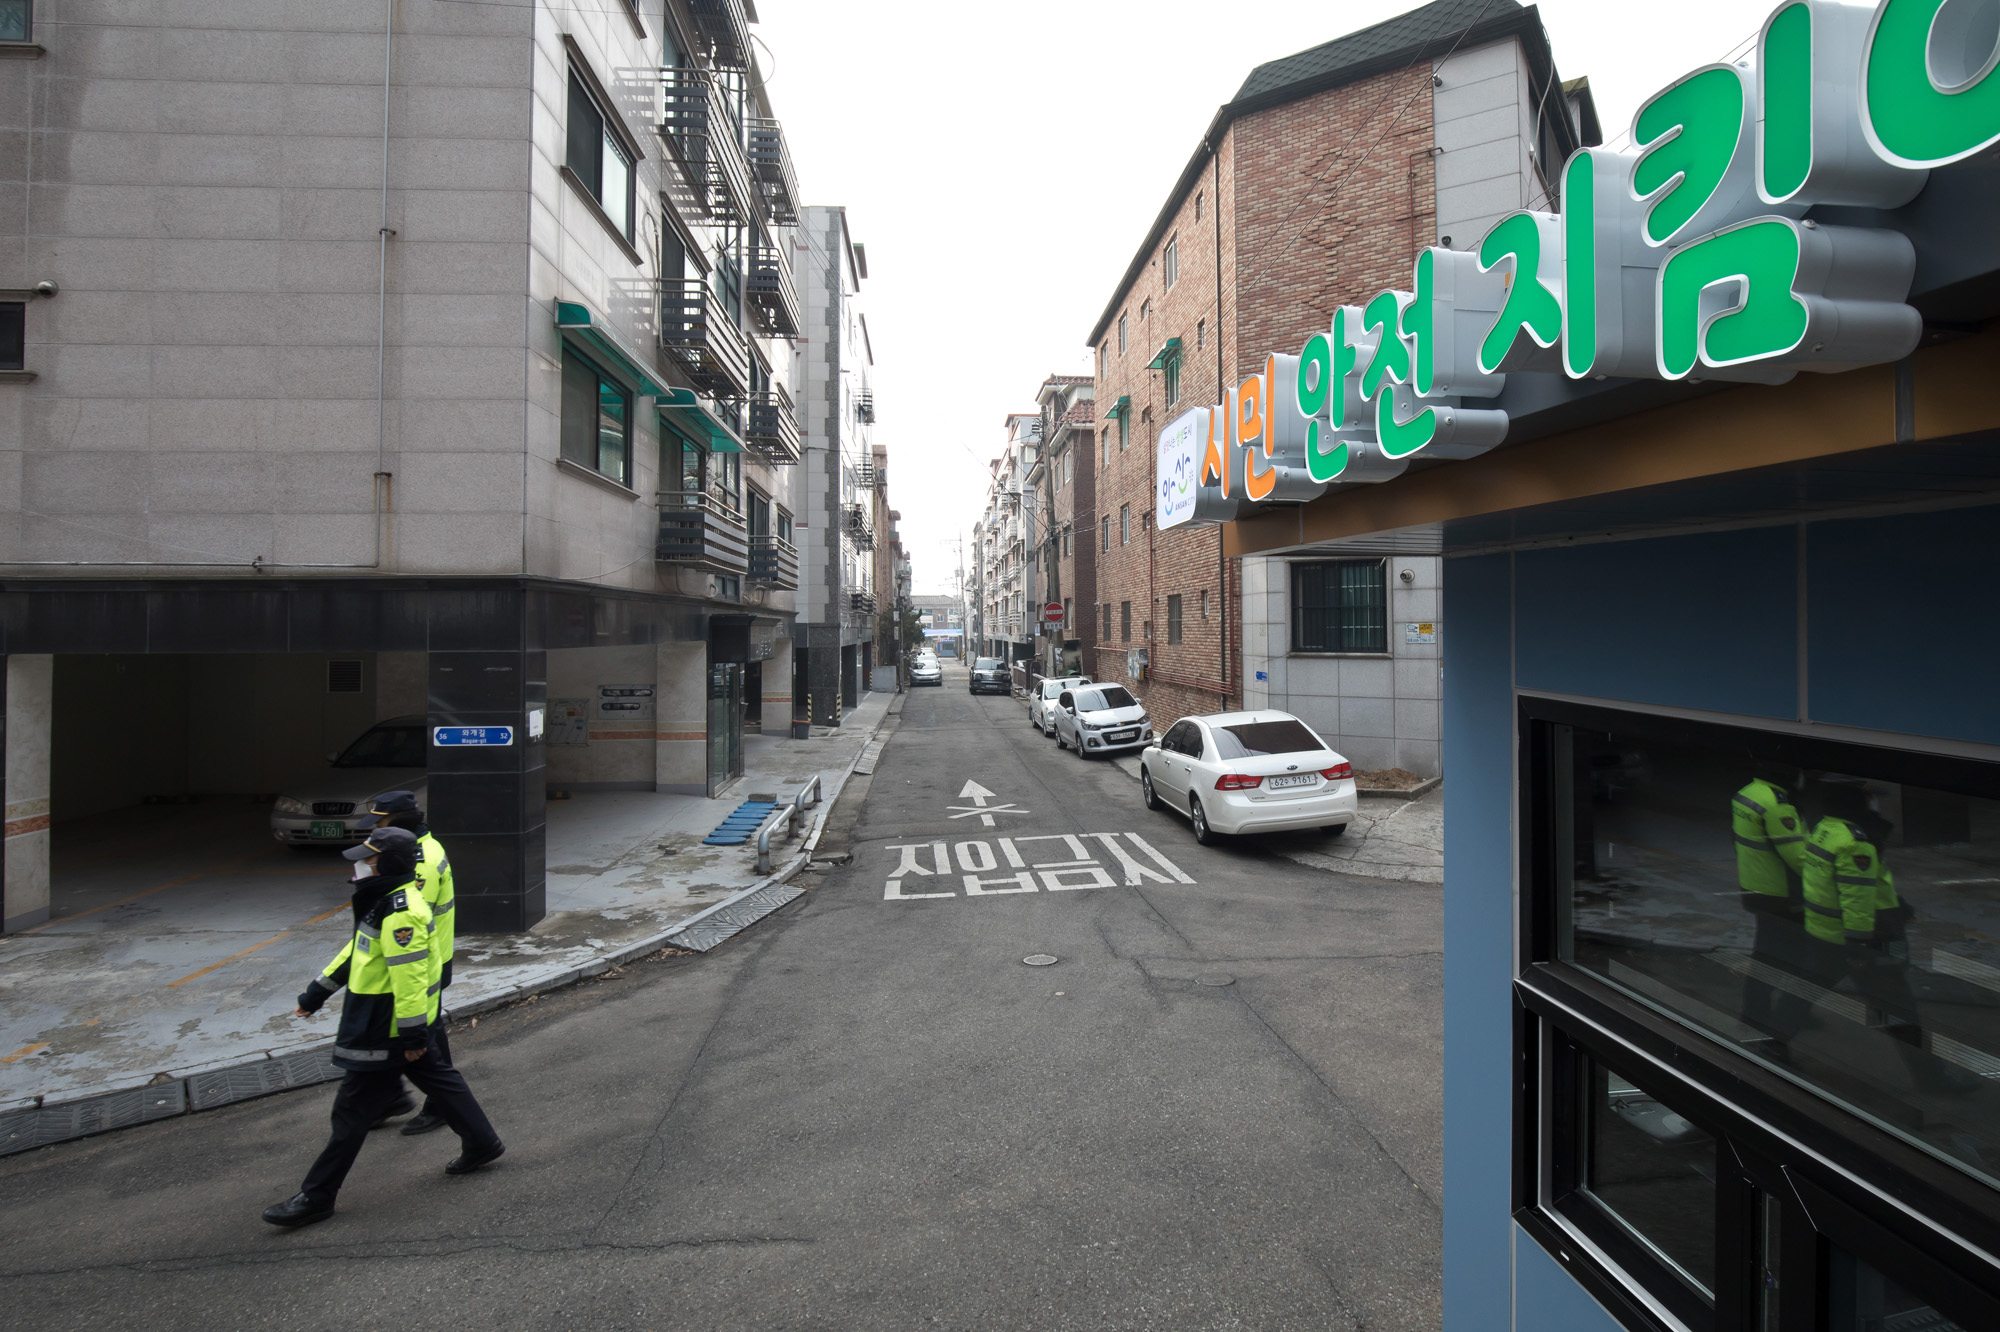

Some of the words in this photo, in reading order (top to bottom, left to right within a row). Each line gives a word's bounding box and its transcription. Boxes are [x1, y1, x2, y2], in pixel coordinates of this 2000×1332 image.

[1200, 354, 1276, 501] 시민
[1296, 246, 1436, 483] 안전
[500, 732, 508, 740] 32
[1291, 775, 1312, 785] 9161
[321, 827, 340, 837] 1501
[884, 832, 1198, 900] 진입금지
